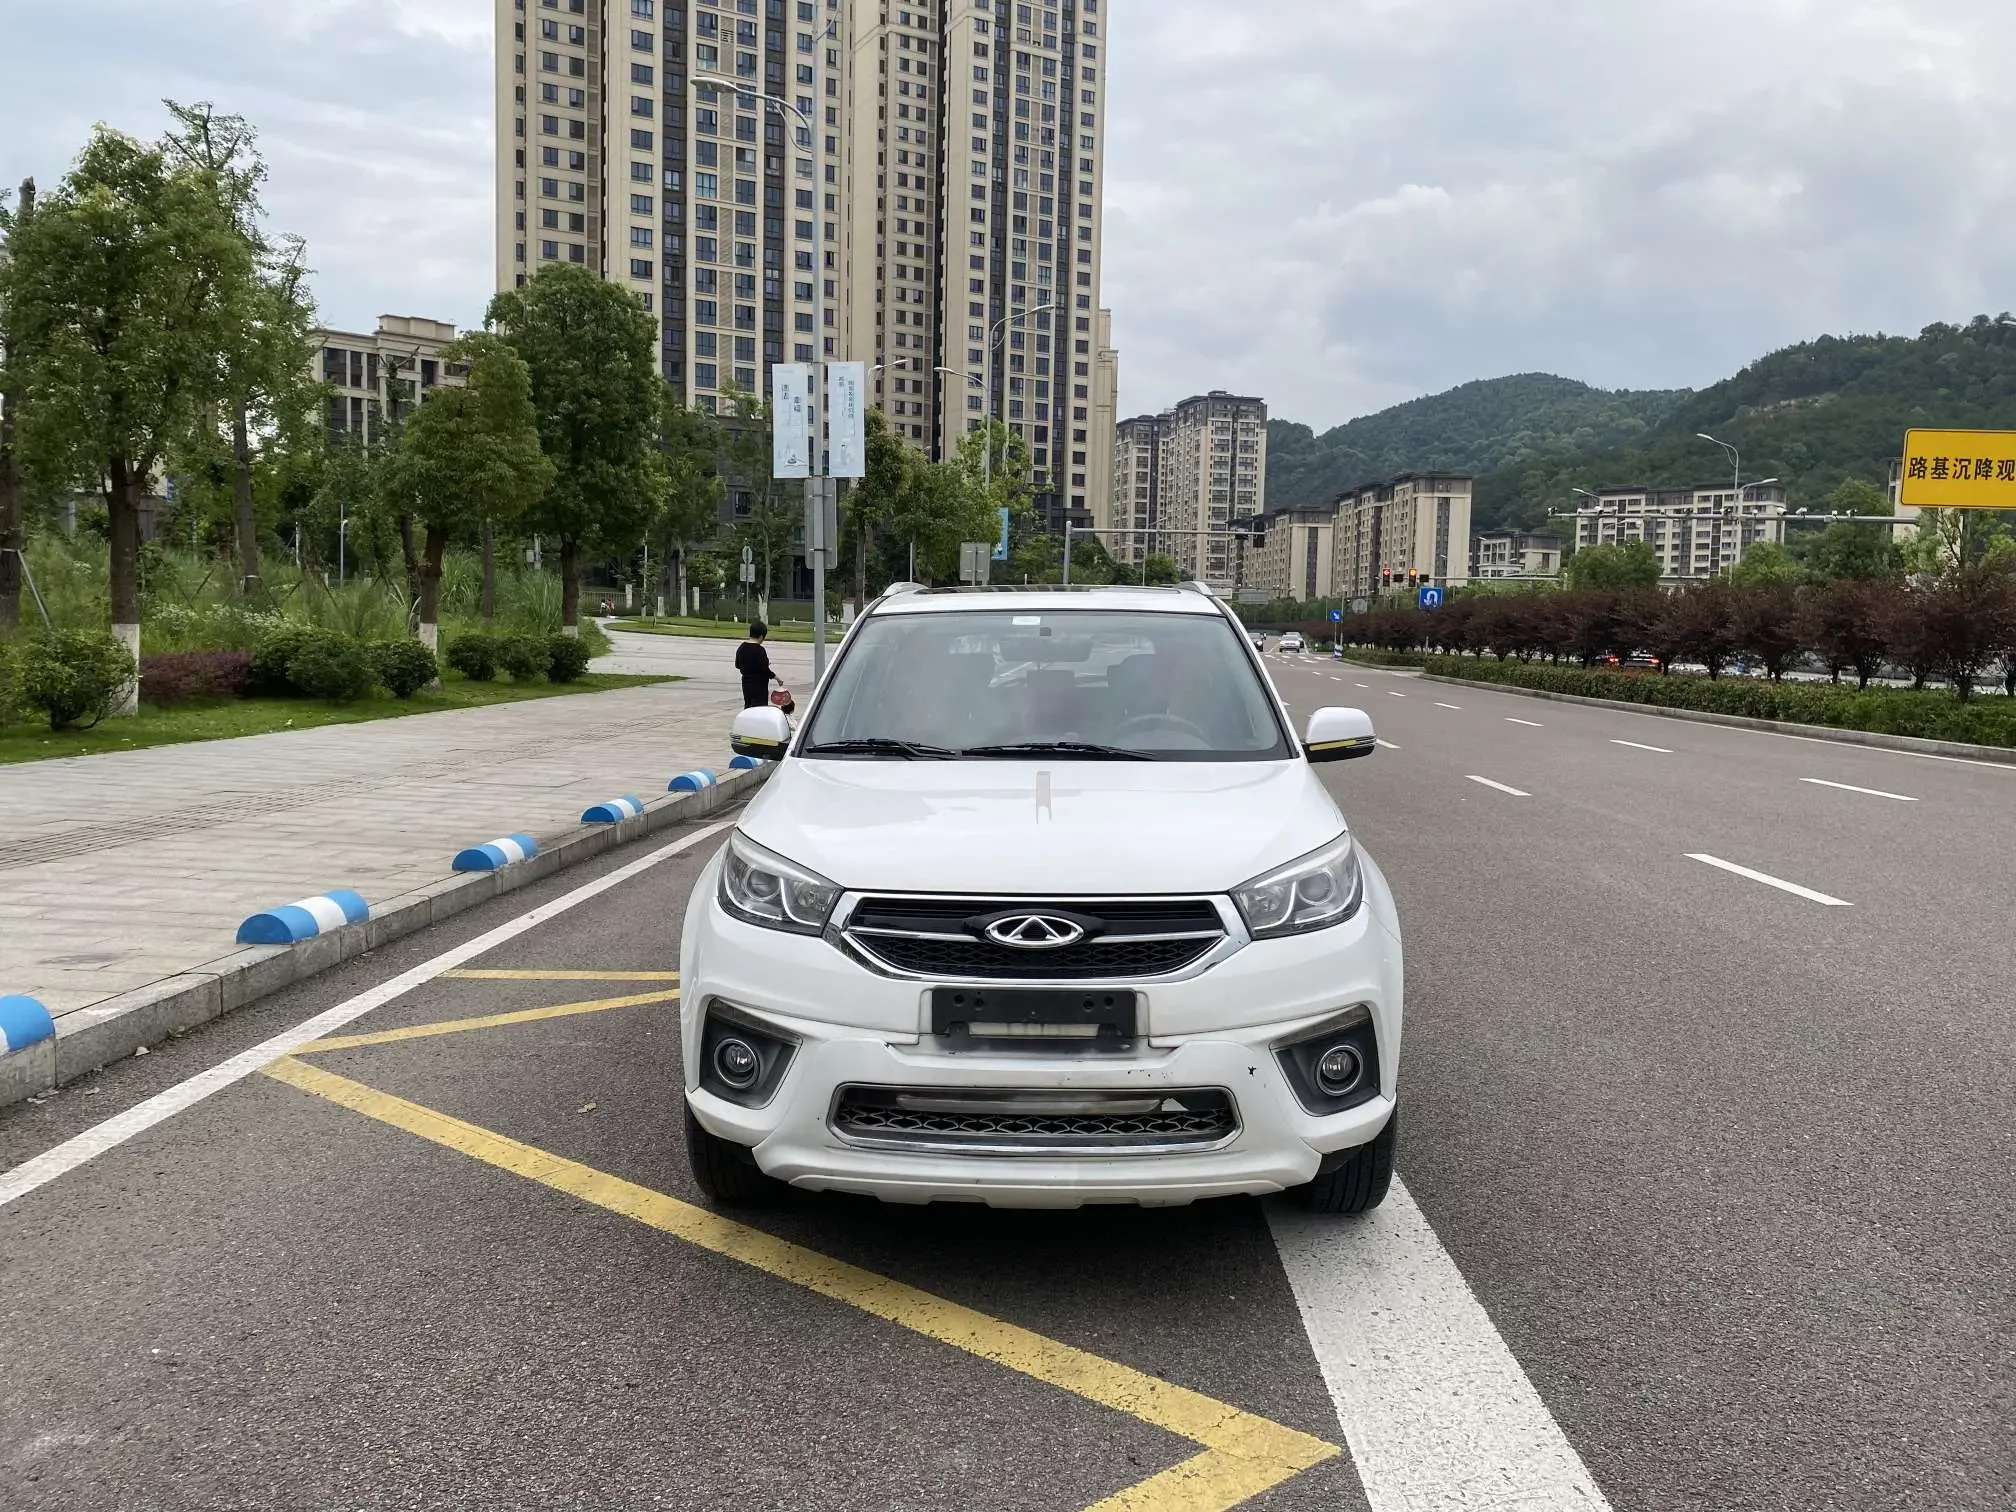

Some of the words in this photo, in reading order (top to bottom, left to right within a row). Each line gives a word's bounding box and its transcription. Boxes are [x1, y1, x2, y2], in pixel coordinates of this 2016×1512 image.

[1908, 456, 2016, 481] 路基沉降观
